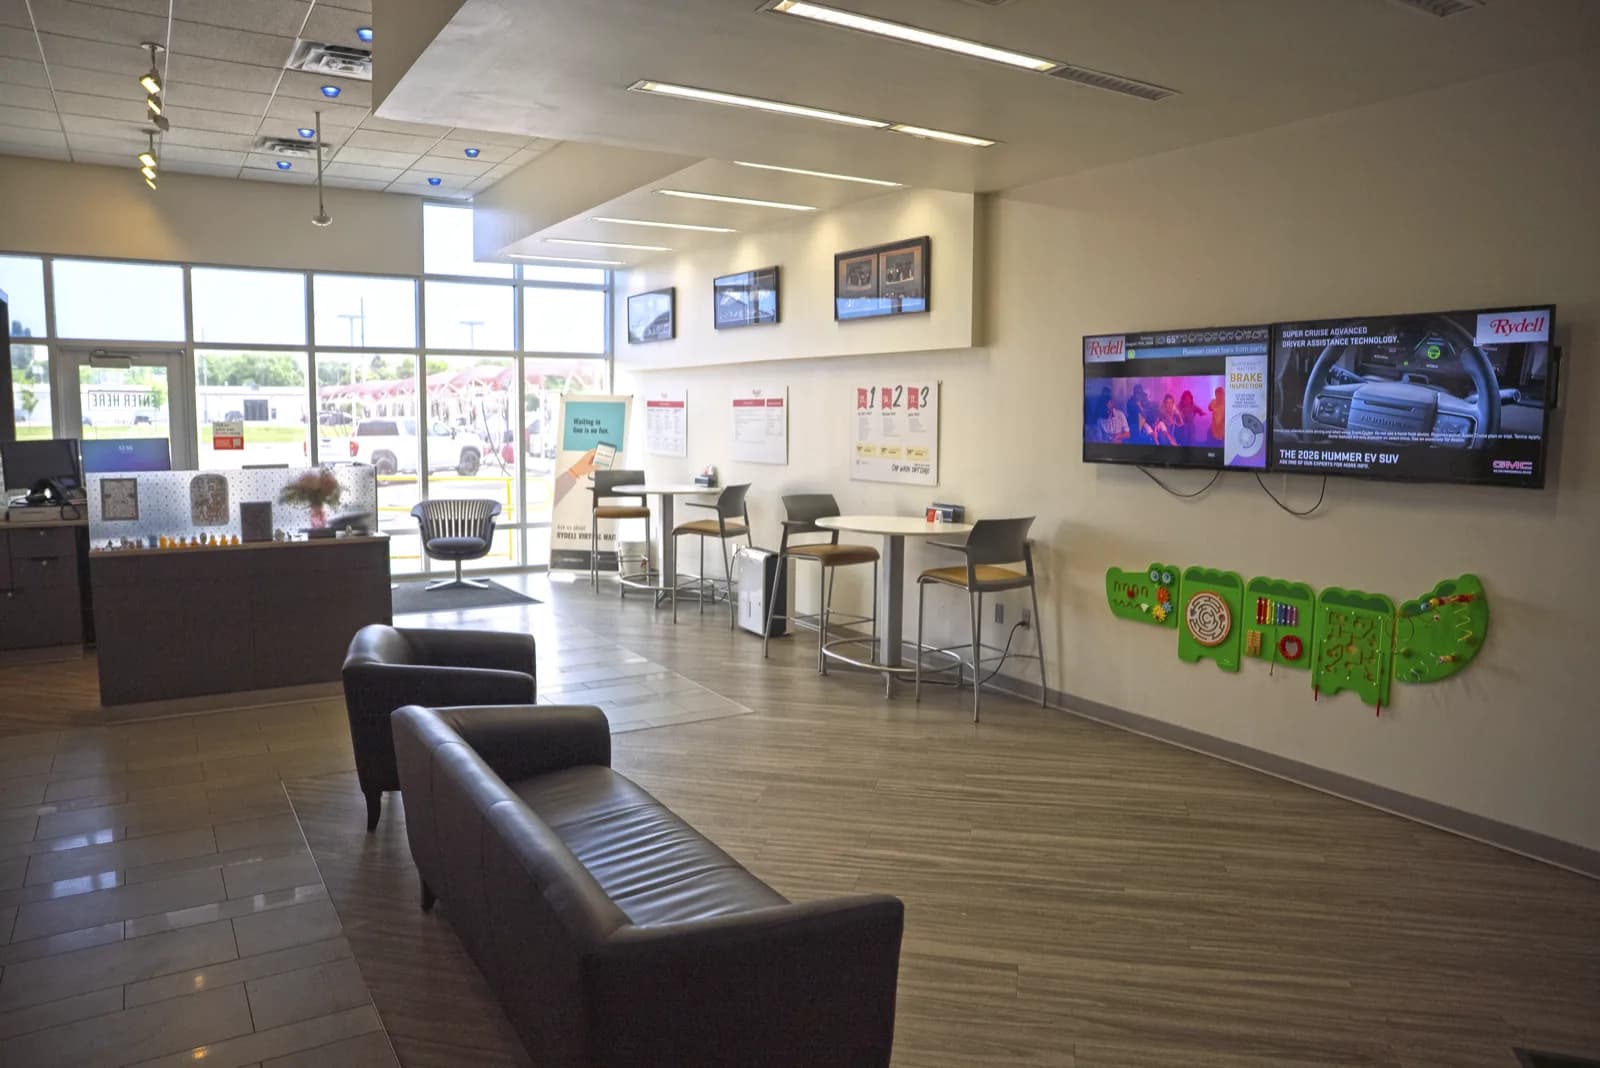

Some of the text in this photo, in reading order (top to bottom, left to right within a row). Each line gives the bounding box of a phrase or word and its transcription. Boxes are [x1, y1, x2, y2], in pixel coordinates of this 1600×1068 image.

[1282, 326, 1368, 338] SUPER CRUISE ADVANCED
[1489, 316, 1545, 337] Rydell
[1088, 339, 1123, 358] Rydell
[1282, 335, 1400, 348] DRIVER ASSISTANCE TECHNOLOGY.
[1230, 372, 1263, 383] BRAKE
[869, 386, 876, 409] 1
[893, 384, 903, 408] 2
[920, 386, 930, 408] 3
[573, 417, 594, 427] Waiting
[1279, 449, 1399, 464] THE 2026 HUMMER EV SUV
[1492, 460, 1533, 470] GMC
[557, 532, 577, 540] RYDELL
